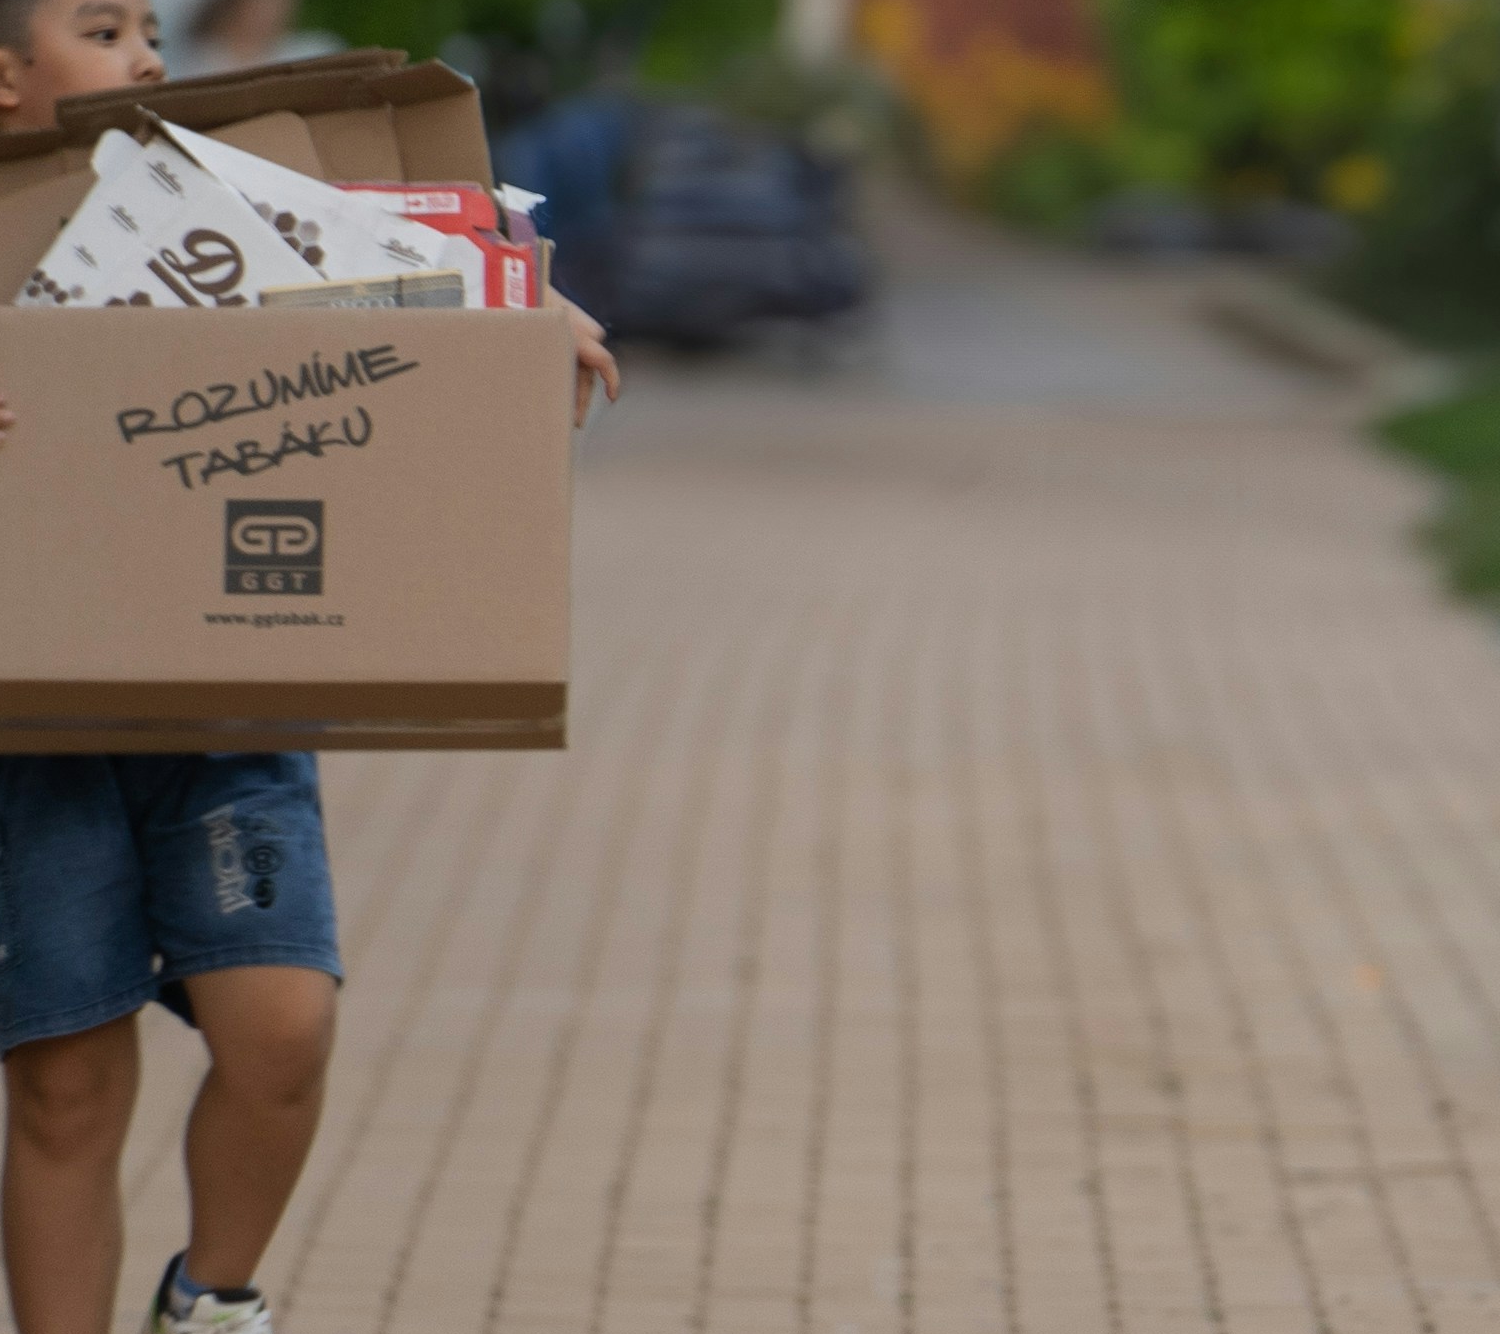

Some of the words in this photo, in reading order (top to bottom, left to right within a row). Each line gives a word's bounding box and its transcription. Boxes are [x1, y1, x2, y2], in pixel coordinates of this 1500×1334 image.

[117, 344, 420, 444] ROZUMÍME
[161, 406, 373, 490] TABÁKU
[240, 571, 308, 592] GGT
